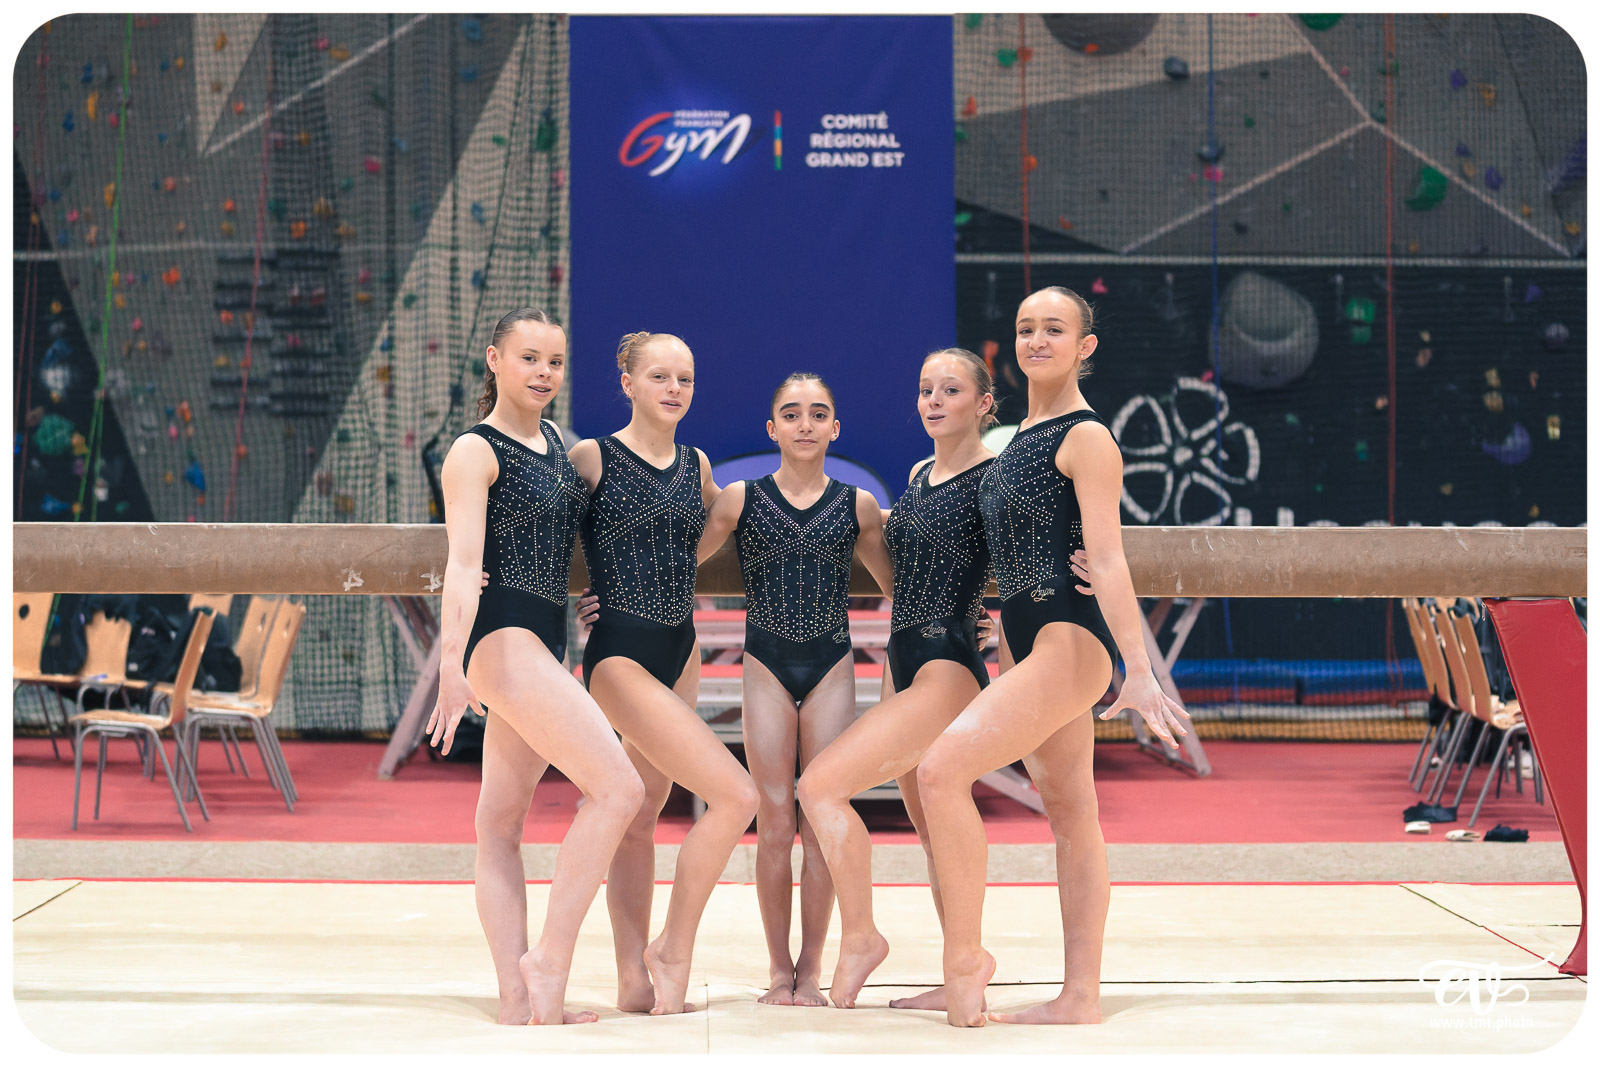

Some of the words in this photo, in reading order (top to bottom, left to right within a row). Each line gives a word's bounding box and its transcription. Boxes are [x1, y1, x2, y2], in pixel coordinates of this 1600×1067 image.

[821, 111, 889, 130] COMITÉ
[809, 132, 901, 149] RÉGIONAL
[805, 152, 870, 168] GRAND
[871, 152, 905, 168] EST
